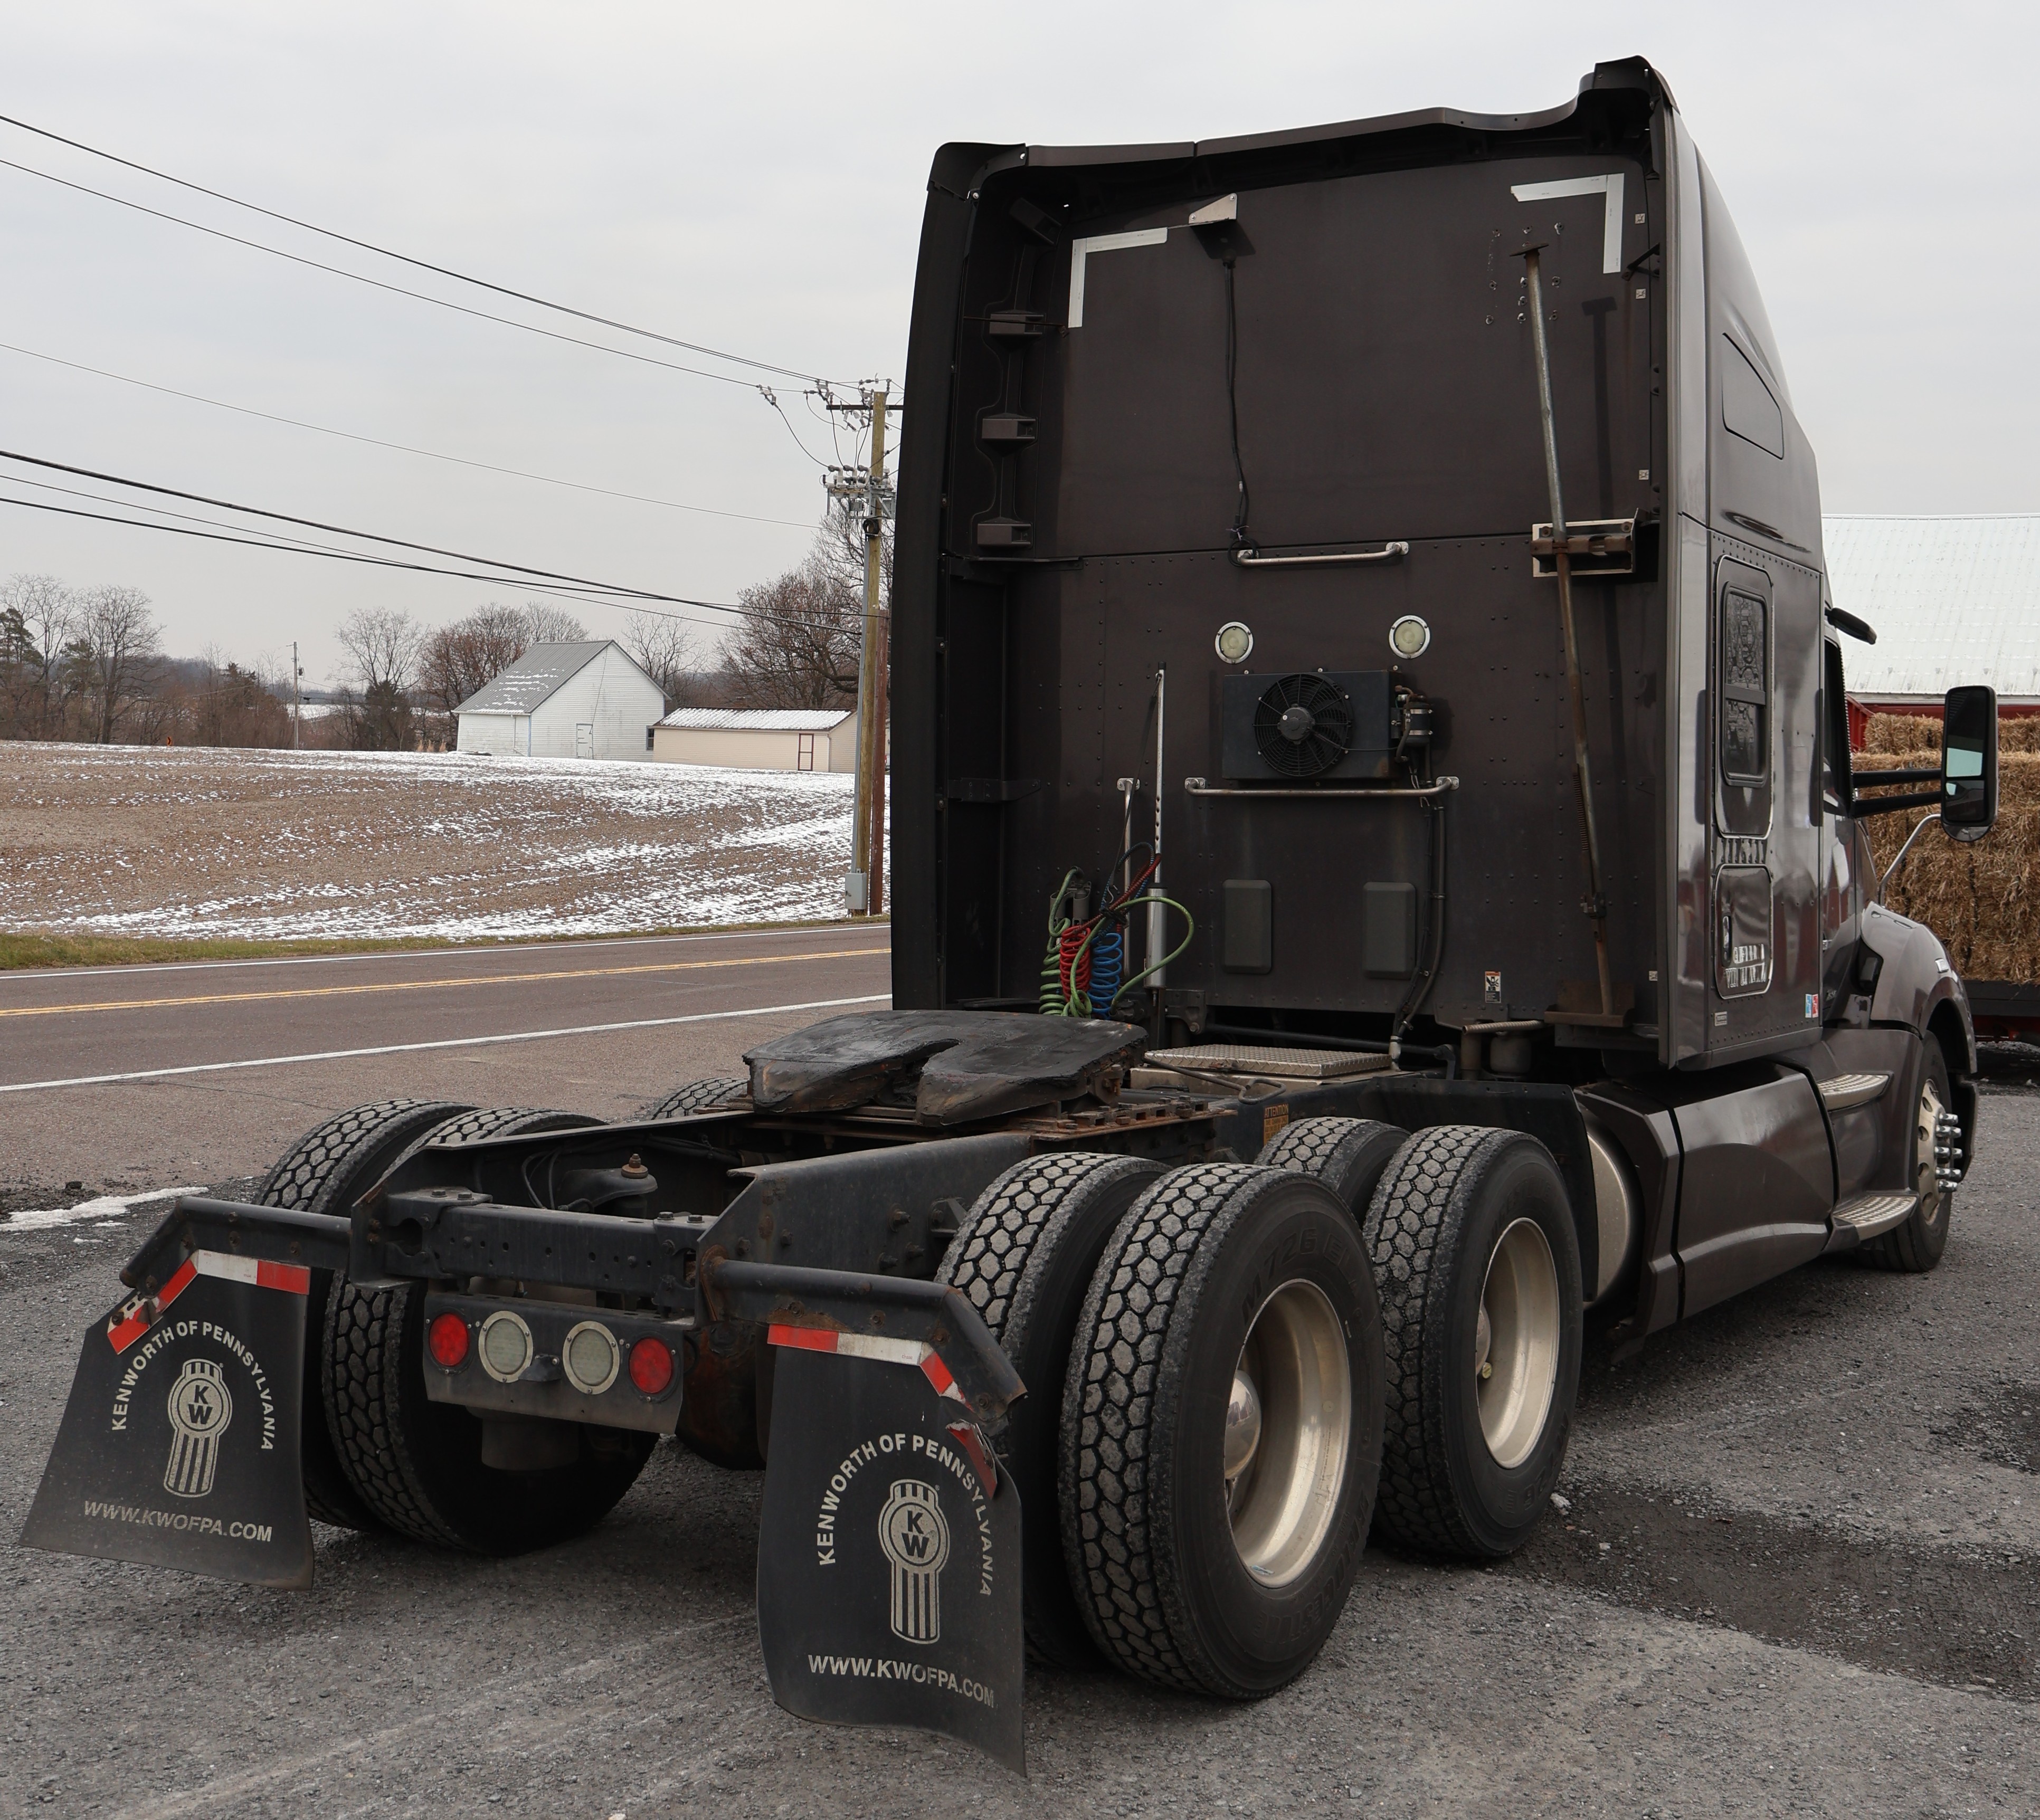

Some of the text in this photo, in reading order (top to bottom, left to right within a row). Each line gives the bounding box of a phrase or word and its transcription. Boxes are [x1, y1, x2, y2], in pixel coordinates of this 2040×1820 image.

[1264, 1103, 1288, 1118] ATTENTION
[1241, 1227, 1317, 1325] M726
[111, 1320, 276, 1450] KENWORTH OF PENNSYLVANIA
[193, 1384, 209, 1404] K
[187, 1403, 214, 1425] W
[84, 1500, 272, 1542] WWW.KWOFPA.COM
[817, 1433, 993, 1596] KENWORTH OF PENNSYLVANIA
[907, 1510, 923, 1532] K
[901, 1532, 930, 1559] W
[808, 1654, 994, 1708] WWW.KWOFPA.COM
